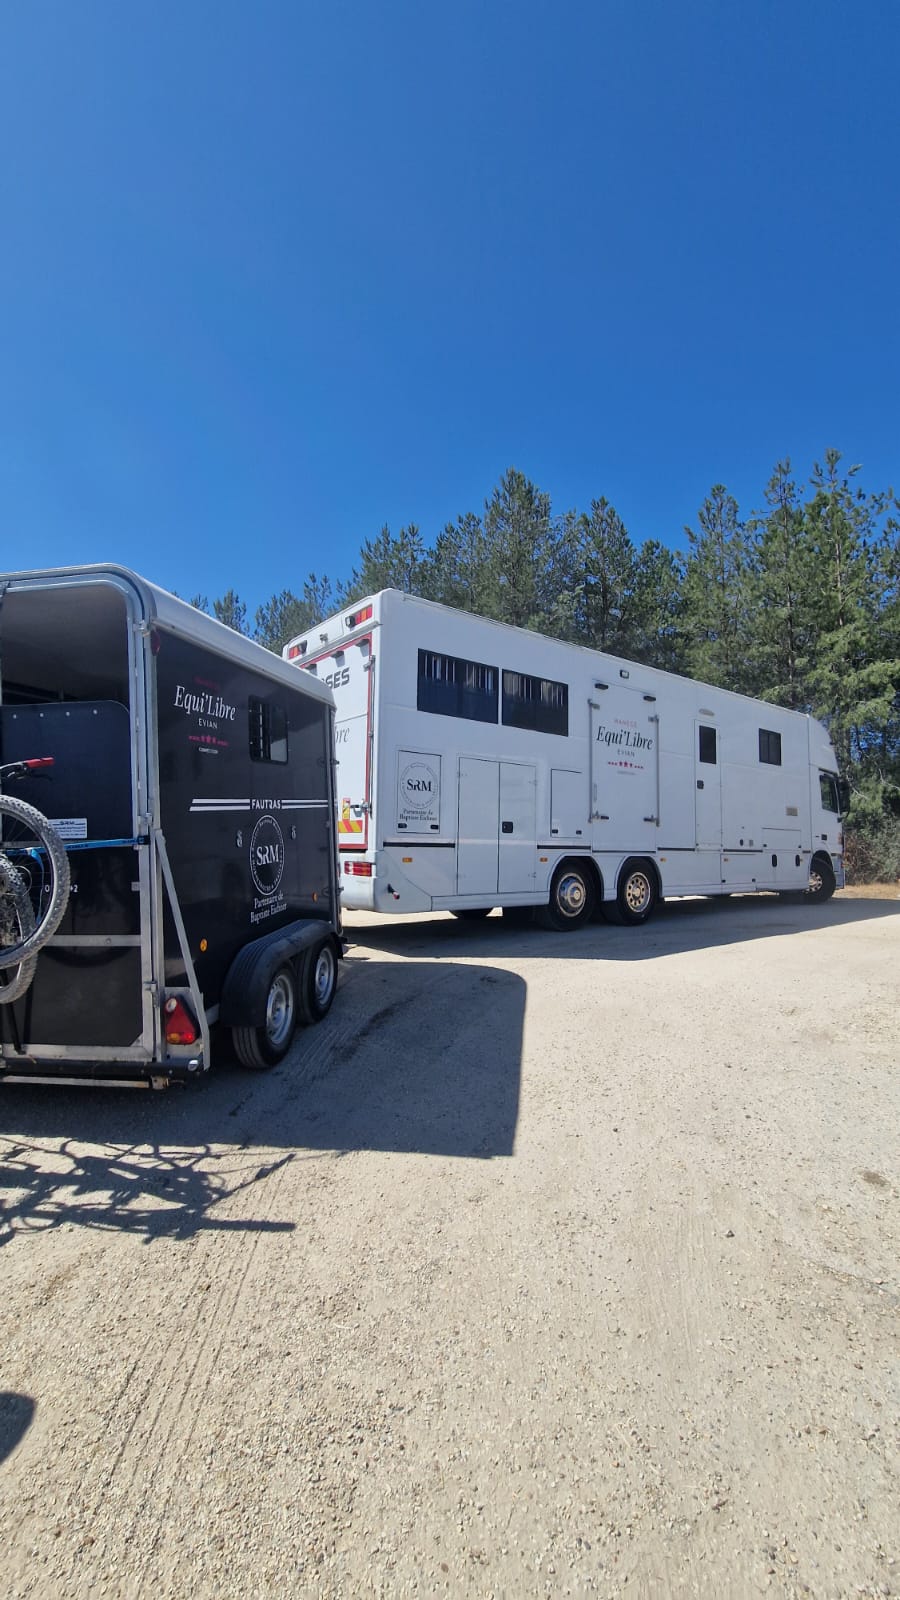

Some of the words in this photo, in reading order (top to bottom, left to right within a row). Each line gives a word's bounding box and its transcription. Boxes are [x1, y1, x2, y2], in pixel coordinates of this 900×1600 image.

[173, 685, 236, 721] Equi'Libre
[198, 718, 218, 729] EVIAN
[596, 725, 654, 750] Equi'Libre
[406, 778, 432, 792] SRM
[251, 799, 281, 809] FAUTRAS
[256, 844, 280, 866] SRM
